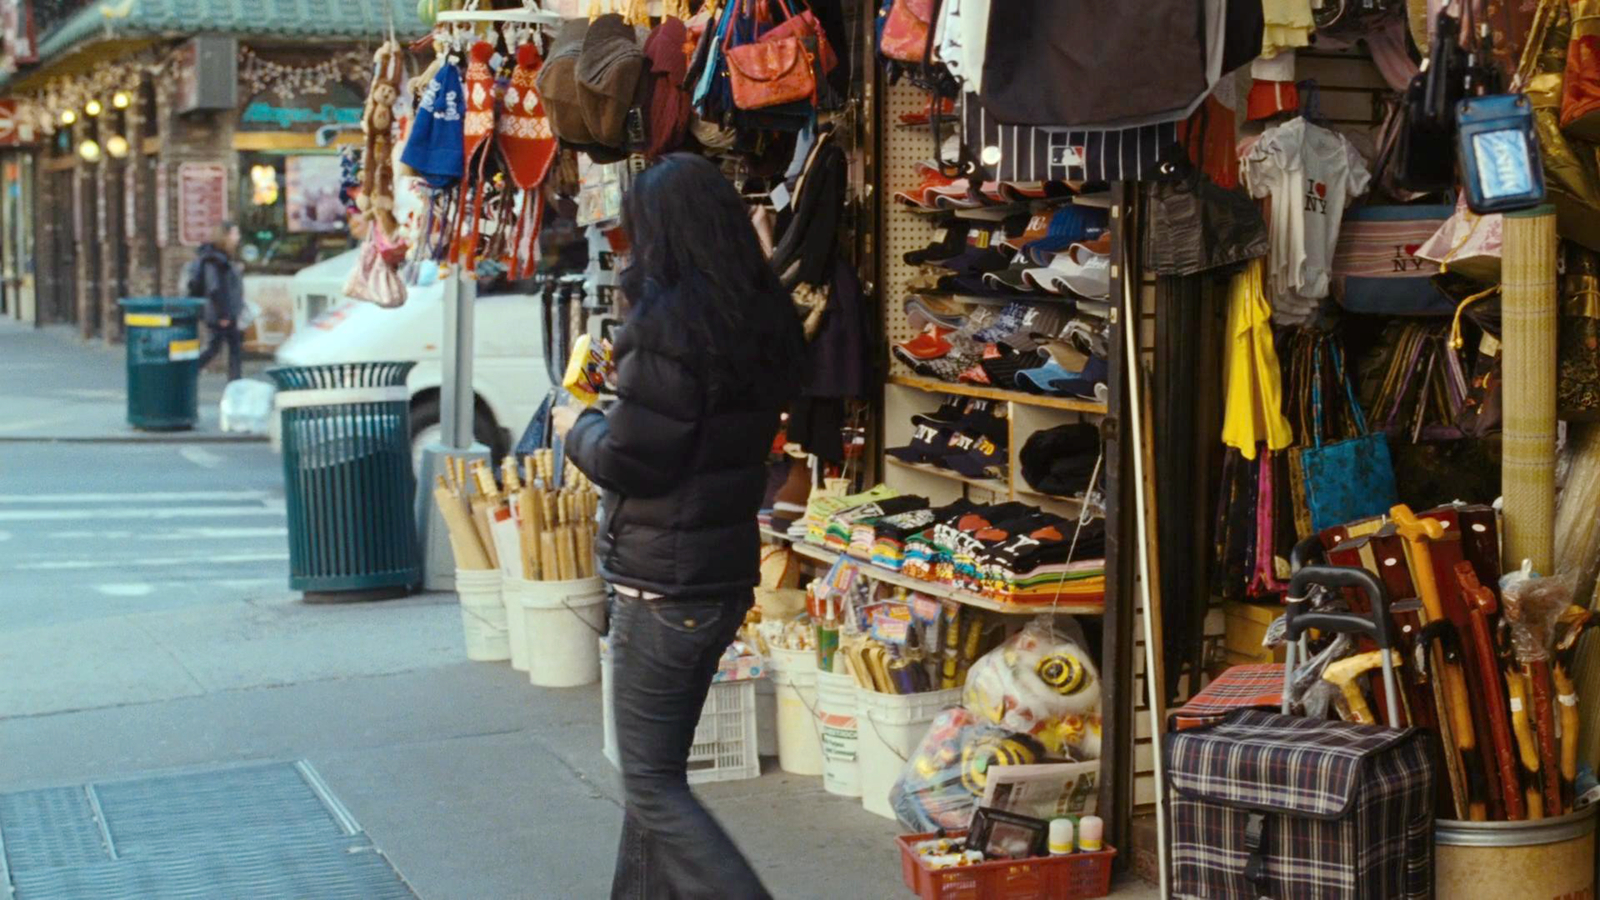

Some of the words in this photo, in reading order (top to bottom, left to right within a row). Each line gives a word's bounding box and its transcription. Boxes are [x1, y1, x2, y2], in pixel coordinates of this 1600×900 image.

[1307, 179, 1315, 195] I
[1304, 195, 1327, 215] NY
[1394, 245, 1404, 258] I
[1391, 258, 1423, 272] NY
[914, 424, 939, 444] NY
[957, 435, 973, 450] NY
